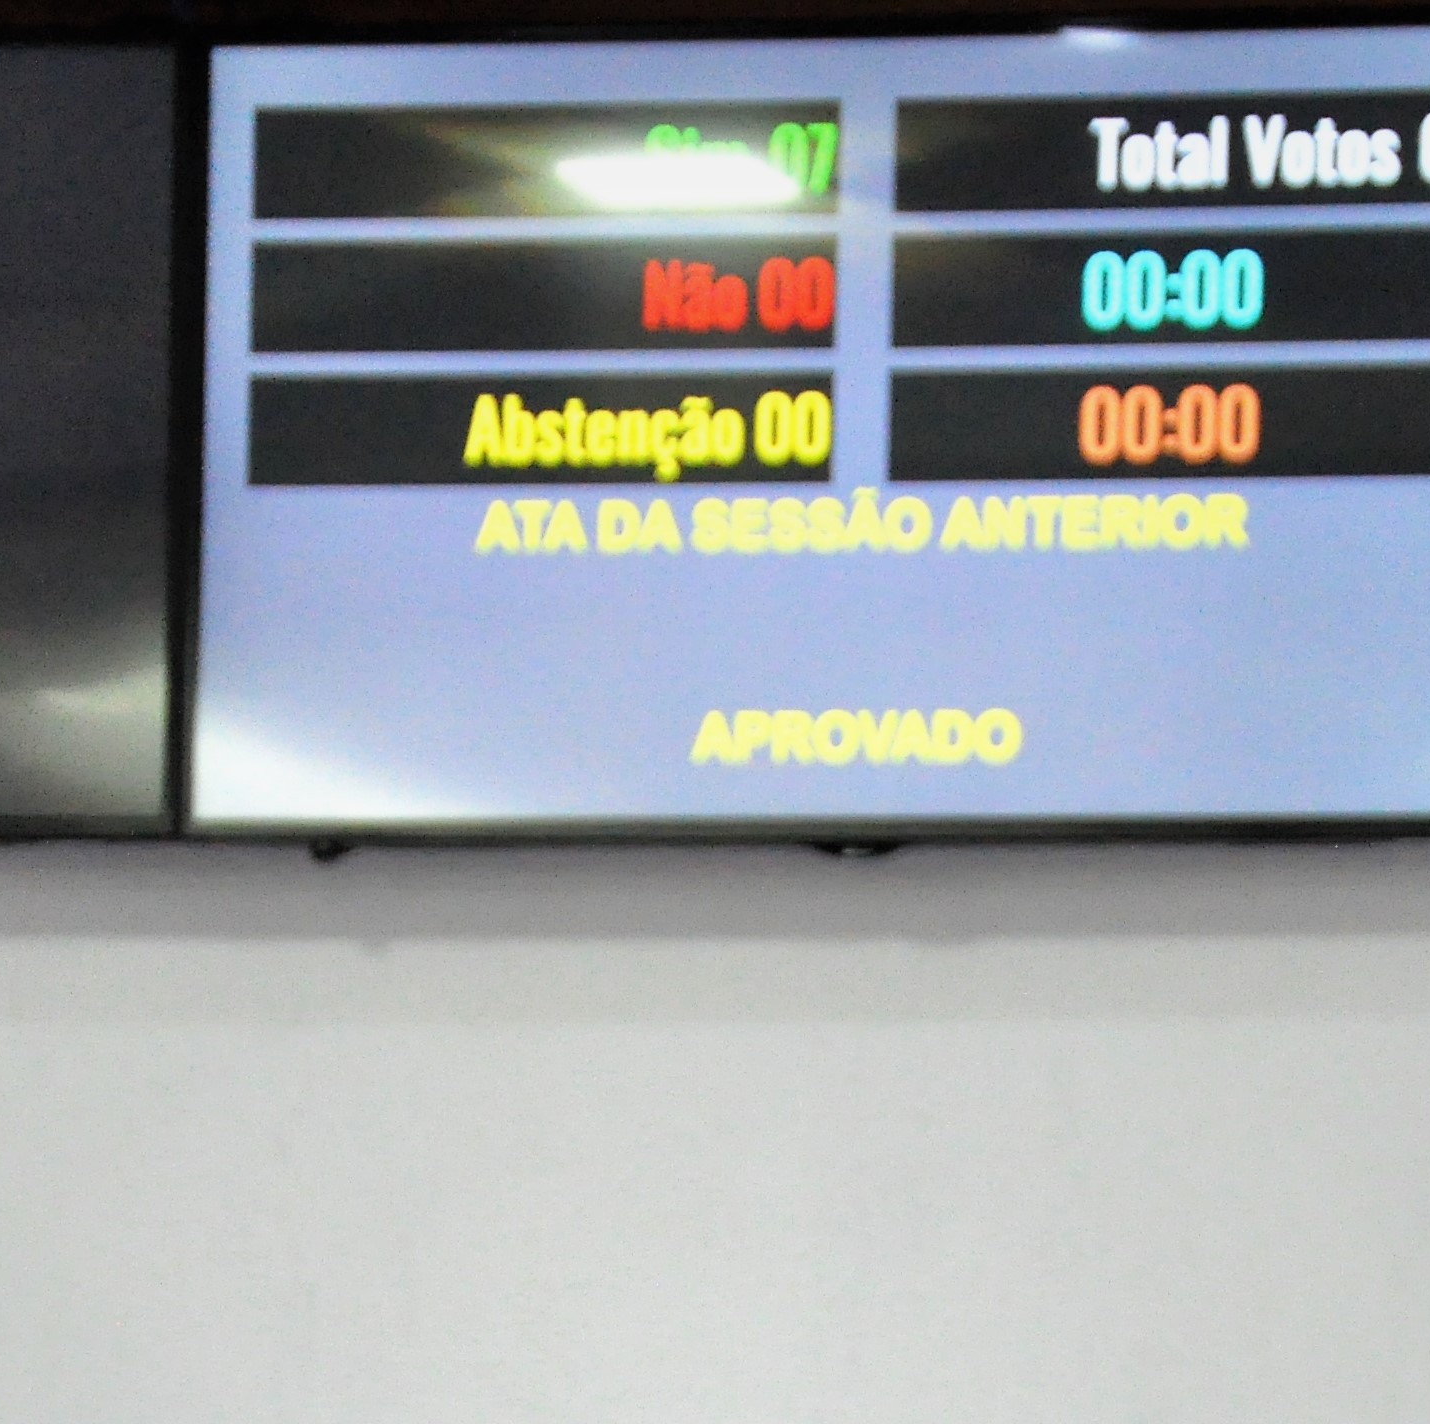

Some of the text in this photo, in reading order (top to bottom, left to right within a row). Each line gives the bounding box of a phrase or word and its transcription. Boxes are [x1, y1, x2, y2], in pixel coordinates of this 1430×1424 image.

[769, 122, 839, 196] 07
[1091, 116, 1229, 188] Total
[1245, 115, 1401, 186] Votos
[643, 256, 835, 331] Não 00
[1081, 249, 1265, 331] 00:00
[464, 390, 832, 482] Abstenção 00
[1079, 383, 1261, 465] 00:00
[478, 489, 1246, 551] ATA DA SESSÃO ANTERIOR
[694, 710, 1021, 761] APROVADO
